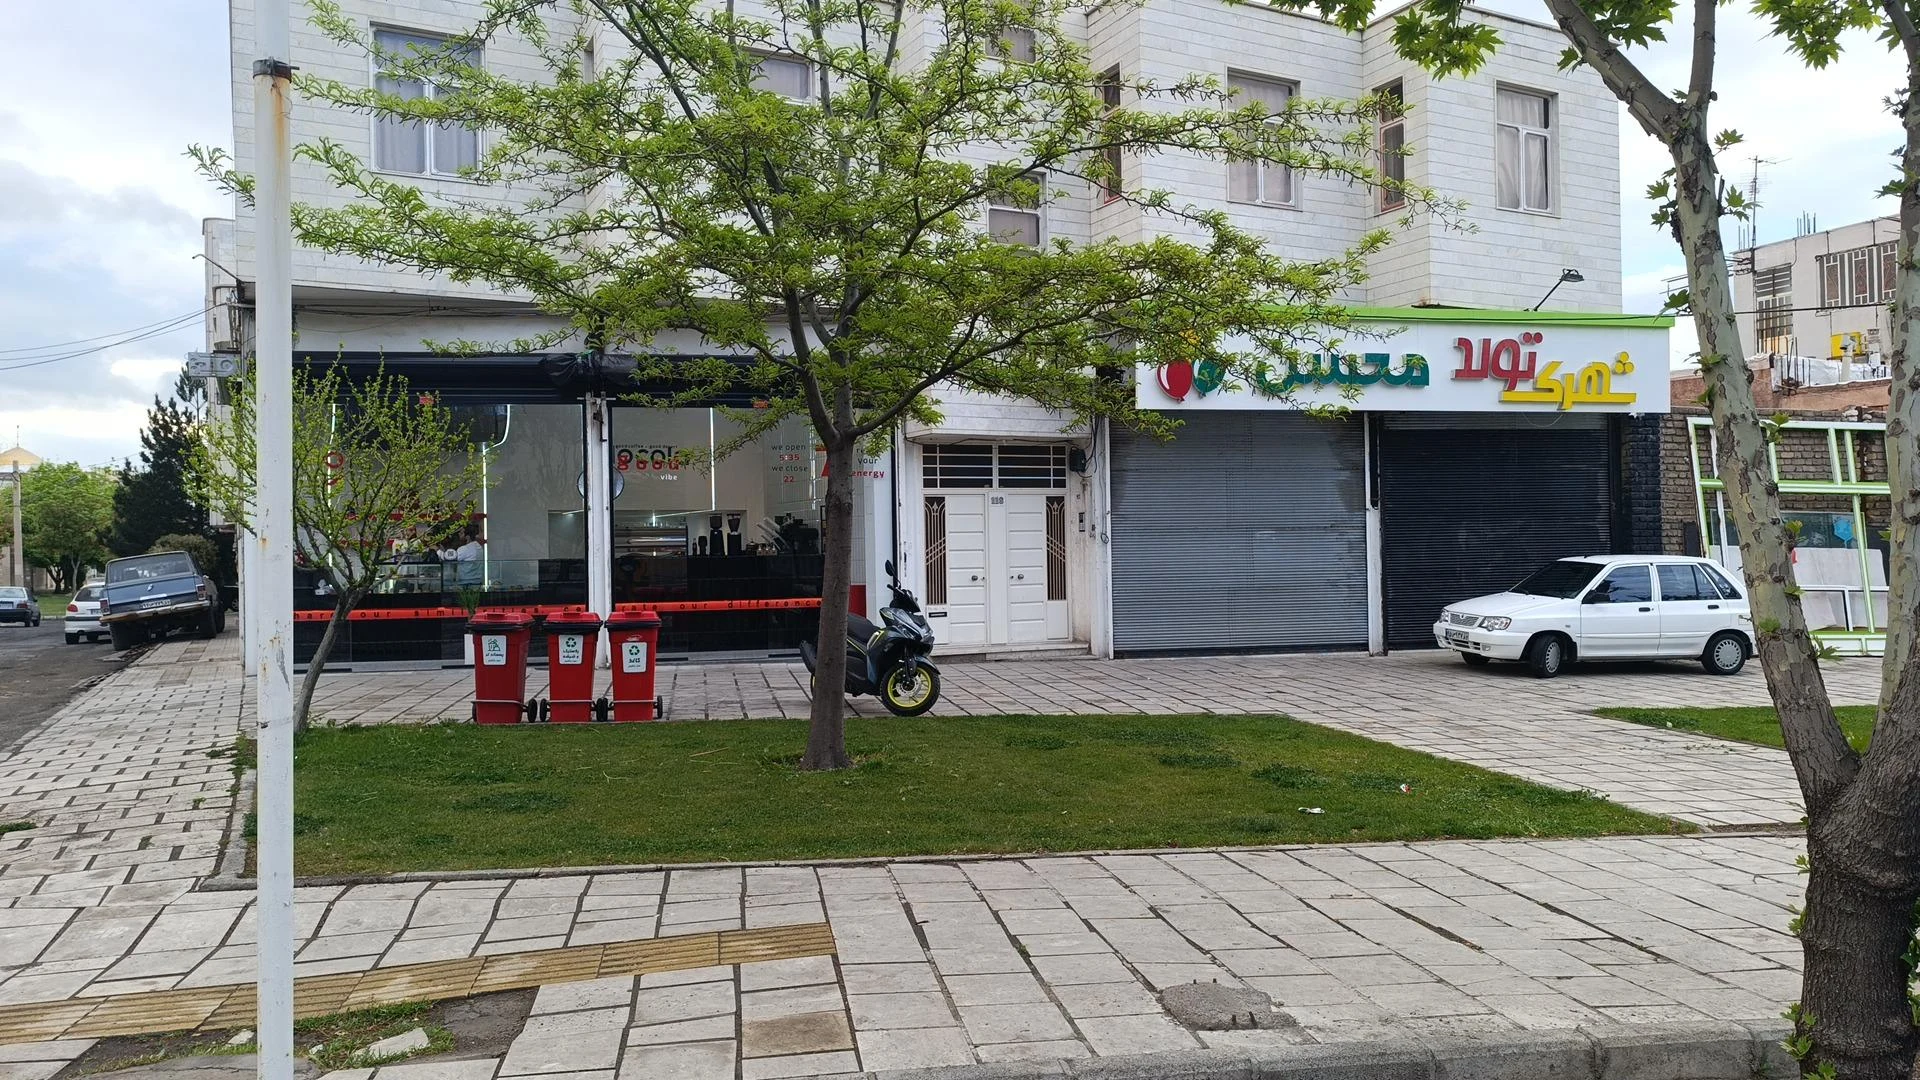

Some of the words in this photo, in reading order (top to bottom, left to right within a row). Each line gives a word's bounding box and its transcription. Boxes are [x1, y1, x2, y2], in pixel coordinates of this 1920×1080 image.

[1452, 331, 1545, 391] تولد
[1501, 351, 1637, 411] شهرک
[660, 473, 678, 481] vibe
[851, 470, 885, 478] energy
